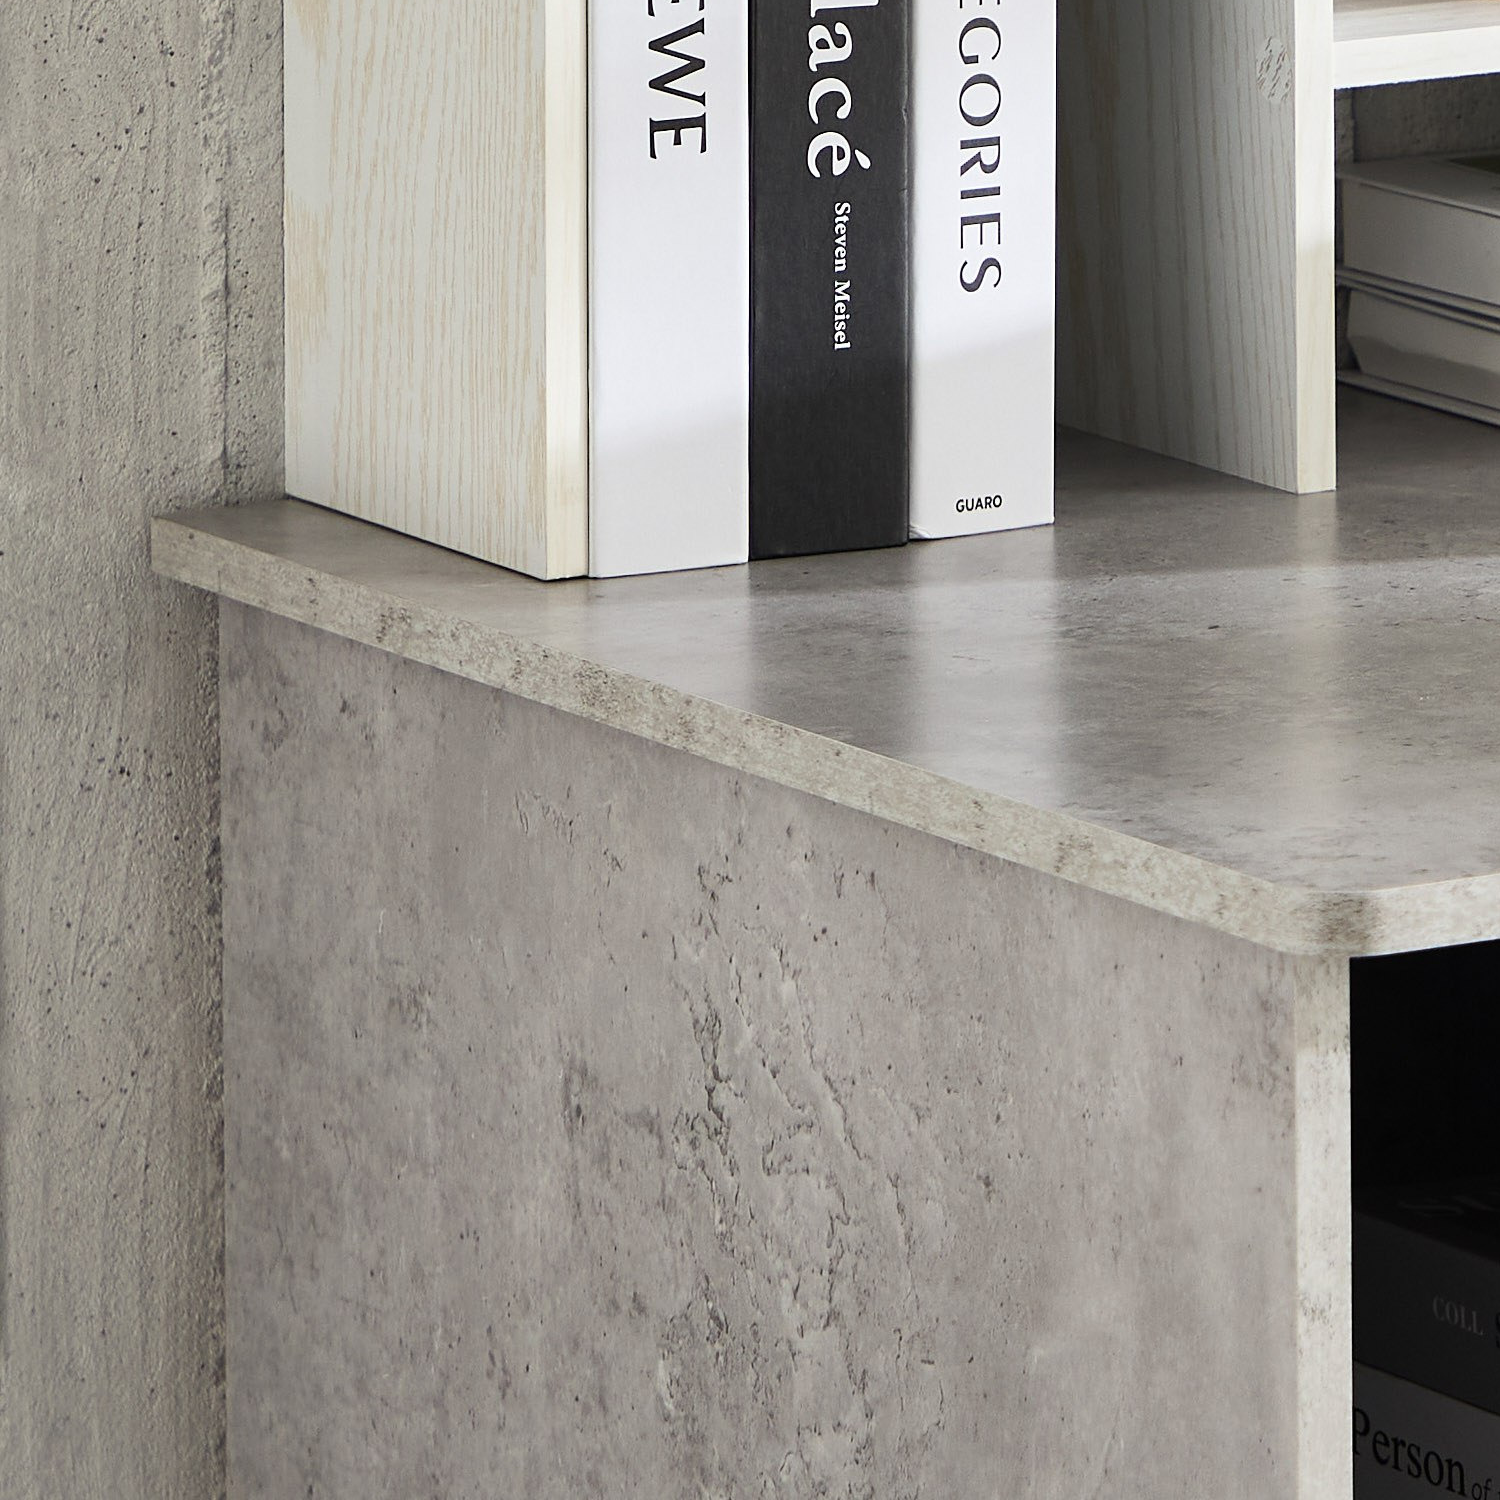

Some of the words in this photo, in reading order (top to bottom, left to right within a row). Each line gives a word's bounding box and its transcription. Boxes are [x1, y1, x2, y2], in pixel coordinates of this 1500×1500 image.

[834, 202, 851, 273] Steven
[833, 279, 851, 351] Meisel
[955, 494, 1003, 513] GUARO
[1352, 1405, 1467, 1497] Person
